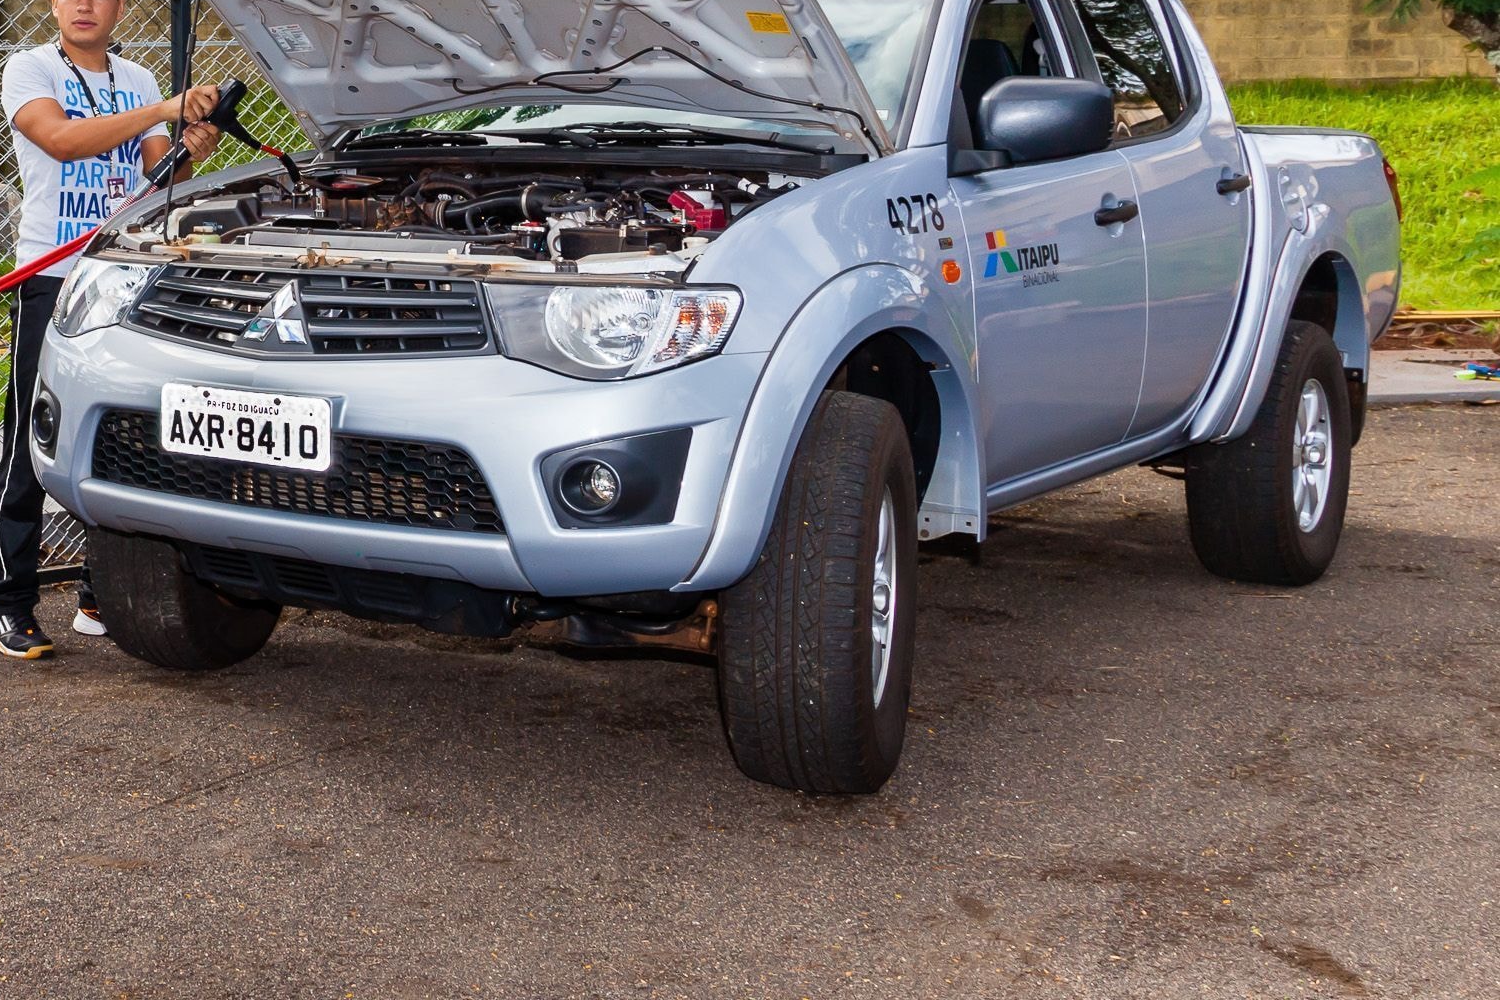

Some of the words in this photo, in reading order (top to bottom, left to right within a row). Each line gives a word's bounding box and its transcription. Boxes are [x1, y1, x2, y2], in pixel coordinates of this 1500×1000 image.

[886, 193, 944, 235] 4278
[1017, 243, 1059, 271] ITAIPU
[238, 403, 249, 412] DO
